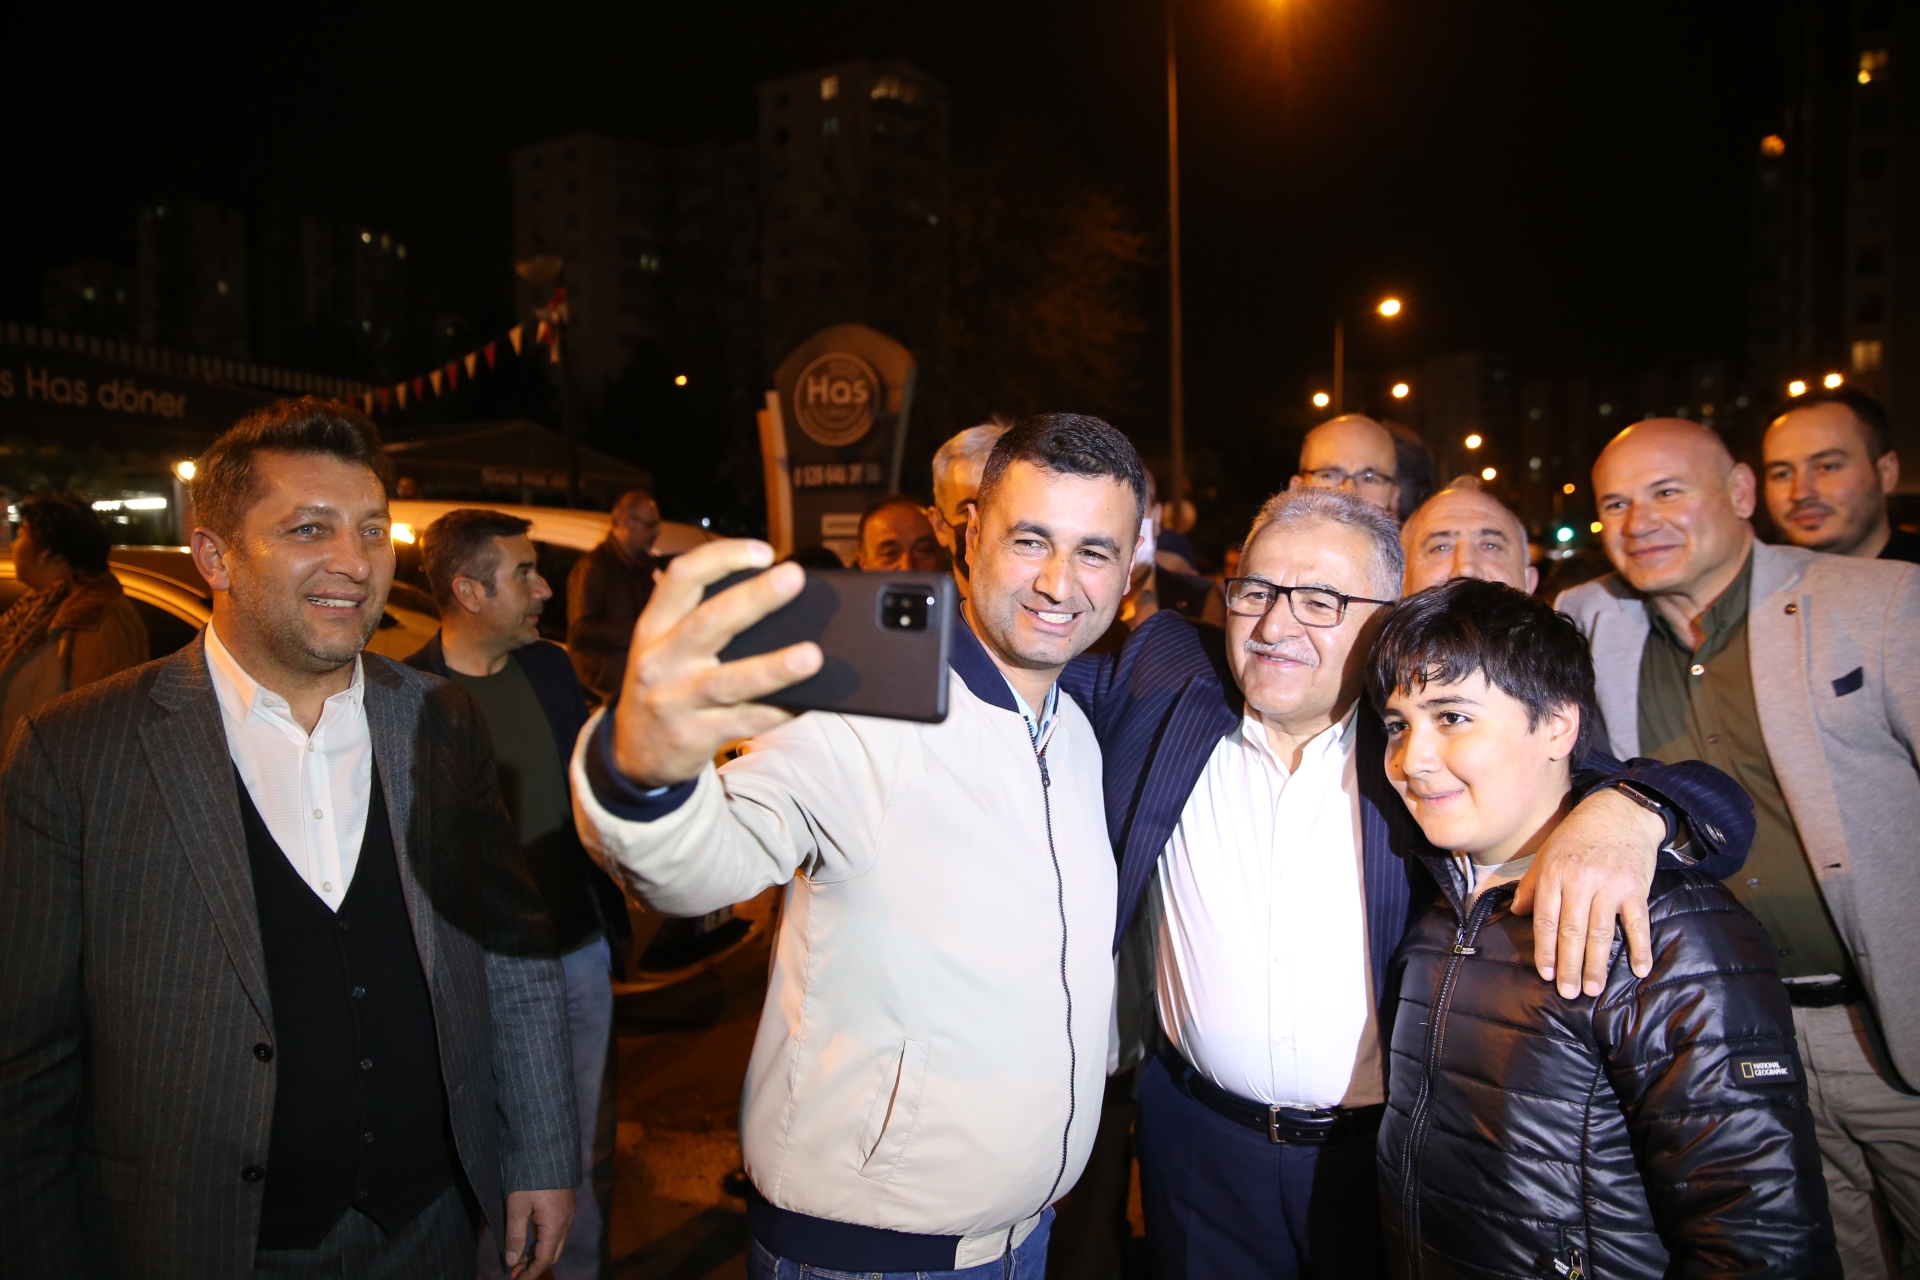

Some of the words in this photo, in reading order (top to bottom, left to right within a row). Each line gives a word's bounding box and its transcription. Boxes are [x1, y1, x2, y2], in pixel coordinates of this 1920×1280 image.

[25, 365, 89, 406] Has
[97, 377, 187, 418] döner
[807, 375, 869, 405] Has
[1752, 1061, 1780, 1069] NATIONAL
[1754, 1067, 1788, 1076] GEOGRAPHIC
